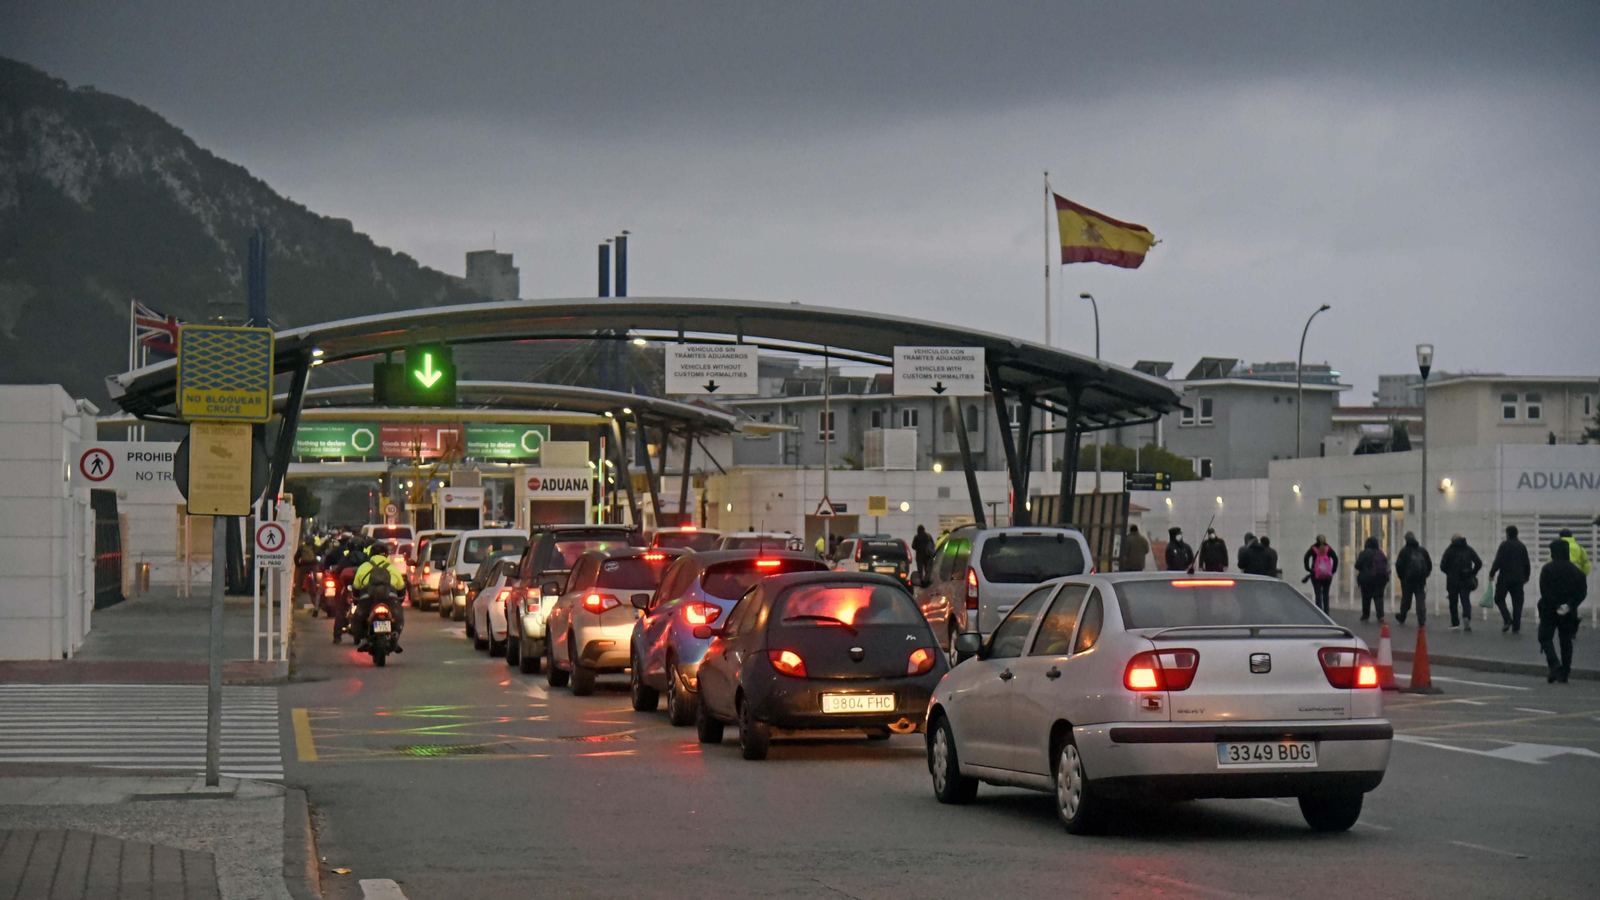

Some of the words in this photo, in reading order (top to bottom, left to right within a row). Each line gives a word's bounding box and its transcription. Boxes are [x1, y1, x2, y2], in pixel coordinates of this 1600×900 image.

[186, 395, 202, 403] NO
[205, 395, 262, 405] BLOQUEAR
[206, 404, 242, 413] CRUCE
[135, 471, 154, 481] NO
[541, 478, 589, 491] ADUANA
[832, 697, 863, 709] 9804
[867, 696, 891, 709] FHC
[1230, 744, 1273, 761] 3349
[1278, 744, 1311, 760] BDG
